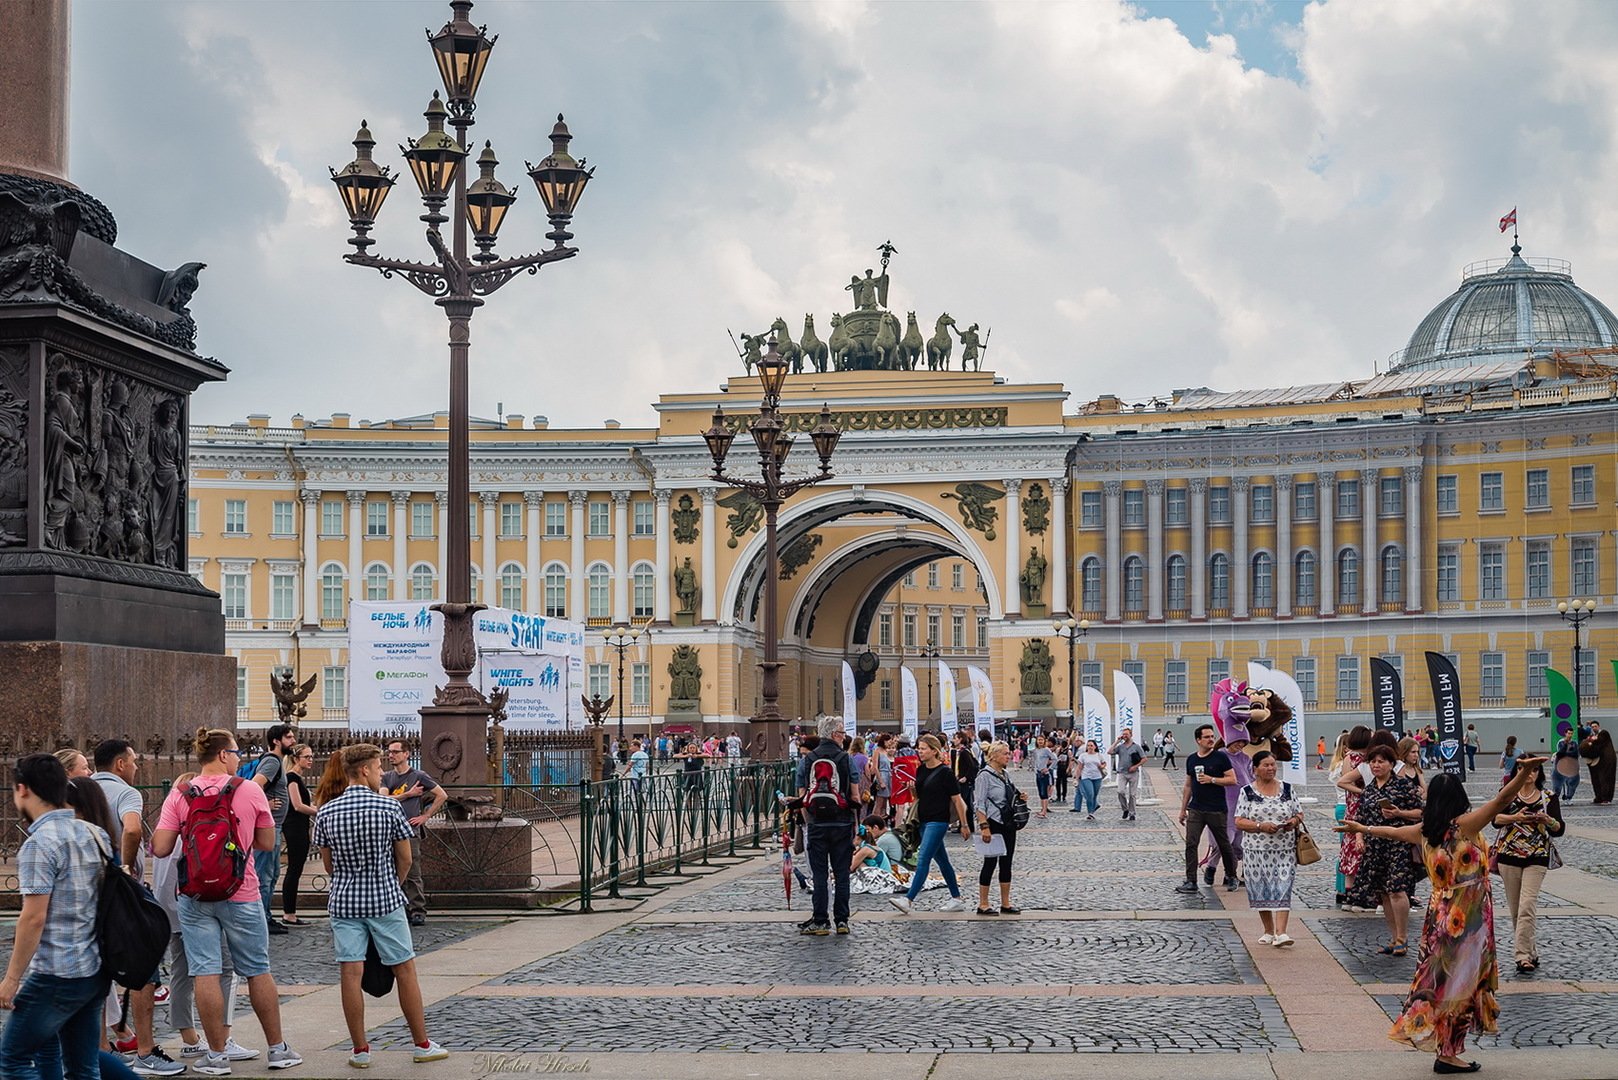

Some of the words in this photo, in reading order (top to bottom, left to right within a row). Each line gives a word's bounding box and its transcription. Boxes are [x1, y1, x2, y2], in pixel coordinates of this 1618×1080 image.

[371, 612, 405, 621] БЕЛЫЕ
[382, 621, 409, 629] НОЧИ
[511, 614, 546, 650] START
[490, 669, 523, 677] WHITE
[498, 678, 534, 687] NIGHTS
[384, 691, 420, 700] OKAN
